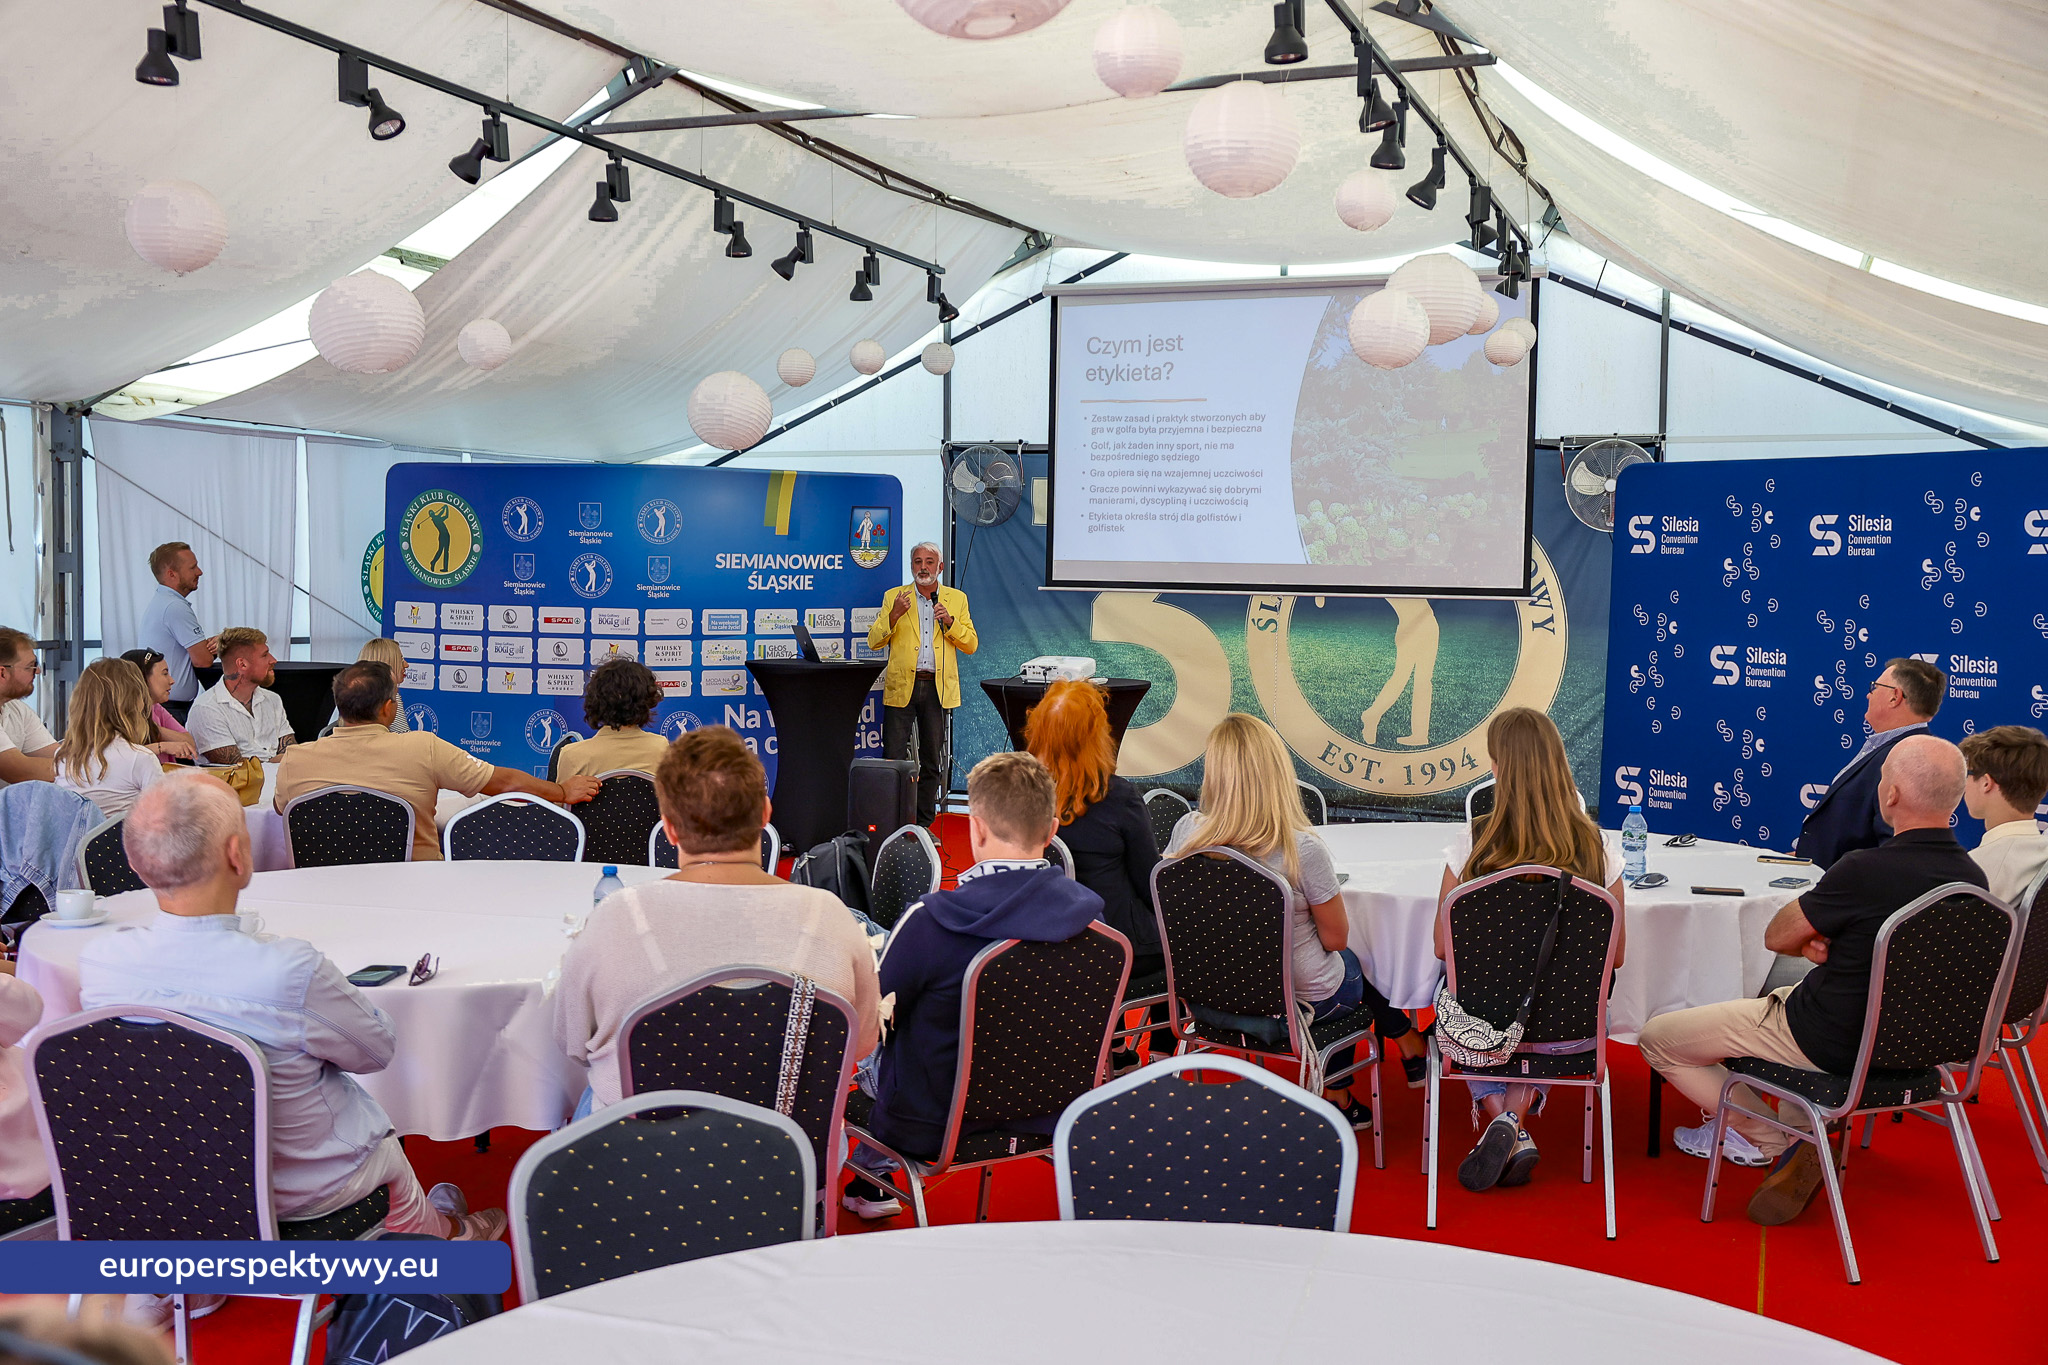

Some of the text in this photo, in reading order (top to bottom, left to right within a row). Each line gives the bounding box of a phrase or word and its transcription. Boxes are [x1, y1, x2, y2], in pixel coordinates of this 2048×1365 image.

[1086, 334, 1184, 358] Czym jest
[1086, 362, 1174, 385] etykieta?
[1124, 414, 1150, 422] zasad
[1156, 414, 1188, 424] praktyk
[1191, 413, 1246, 424] stworzonych
[1250, 413, 1266, 422] aby
[1091, 427, 1104, 435] gra
[1116, 426, 1136, 435] golfa
[1139, 425, 1156, 434] była
[1159, 426, 1204, 434] przyjemna
[1211, 425, 1262, 434] bezpieczna
[1091, 442, 1111, 451] Golf,
[1113, 442, 1126, 451] jak
[1128, 442, 1154, 450] żaden
[1156, 442, 1174, 451] inny
[1177, 443, 1202, 451] sport,
[1091, 453, 1200, 462] bezpośredniego sędziego
[1108, 470, 1134, 479] opiera
[1164, 470, 1211, 479] wzajemnej
[1214, 469, 1263, 478] uczciwości
[1122, 486, 1156, 495] powinni
[1158, 485, 1206, 495] wykazywać
[1209, 486, 1222, 495] się
[1225, 486, 1262, 495] dobrymi
[1089, 497, 1138, 506] manierami,
[1140, 497, 1187, 506] dyscypliną
[1194, 497, 1248, 507] uczciwością
[400, 492, 480, 538] ŚLĄSKI KLUB GOLFOWY
[1088, 512, 1123, 521] Etykieta
[1125, 512, 1156, 521] określa
[1159, 513, 1179, 522] strój
[1196, 513, 1237, 523] golfistów
[1088, 524, 1124, 533] golfistek
[1662, 516, 1699, 532] Silesia
[1848, 514, 1892, 532] Silesia
[1661, 534, 1698, 544] Convention
[1848, 534, 1892, 544] Convention
[1661, 545, 1685, 554] Bureau
[1848, 545, 1876, 556] Bureau
[715, 553, 843, 570] SIEMIANOWICE
[405, 553, 478, 585] SIEMIANOWICE ŚLĄSKIE
[748, 572, 814, 593] ŚLĄSKIE
[648, 590, 670, 599] Śląskie
[1746, 646, 1787, 665] Silesia
[1950, 654, 1998, 674] Silesia
[1746, 666, 1786, 678] Convention
[1745, 677, 1771, 688] Bureau
[1950, 675, 1997, 688] Convention
[1950, 687, 1980, 699] Bureau
[724, 704, 760, 728] Na
[460, 738, 501, 746] Siemianowice
[1317, 740, 1479, 786] EST. 1994
[1649, 769, 1688, 788] Silesia
[1649, 787, 1686, 800] Convention
[1648, 798, 1672, 810] Bureau
